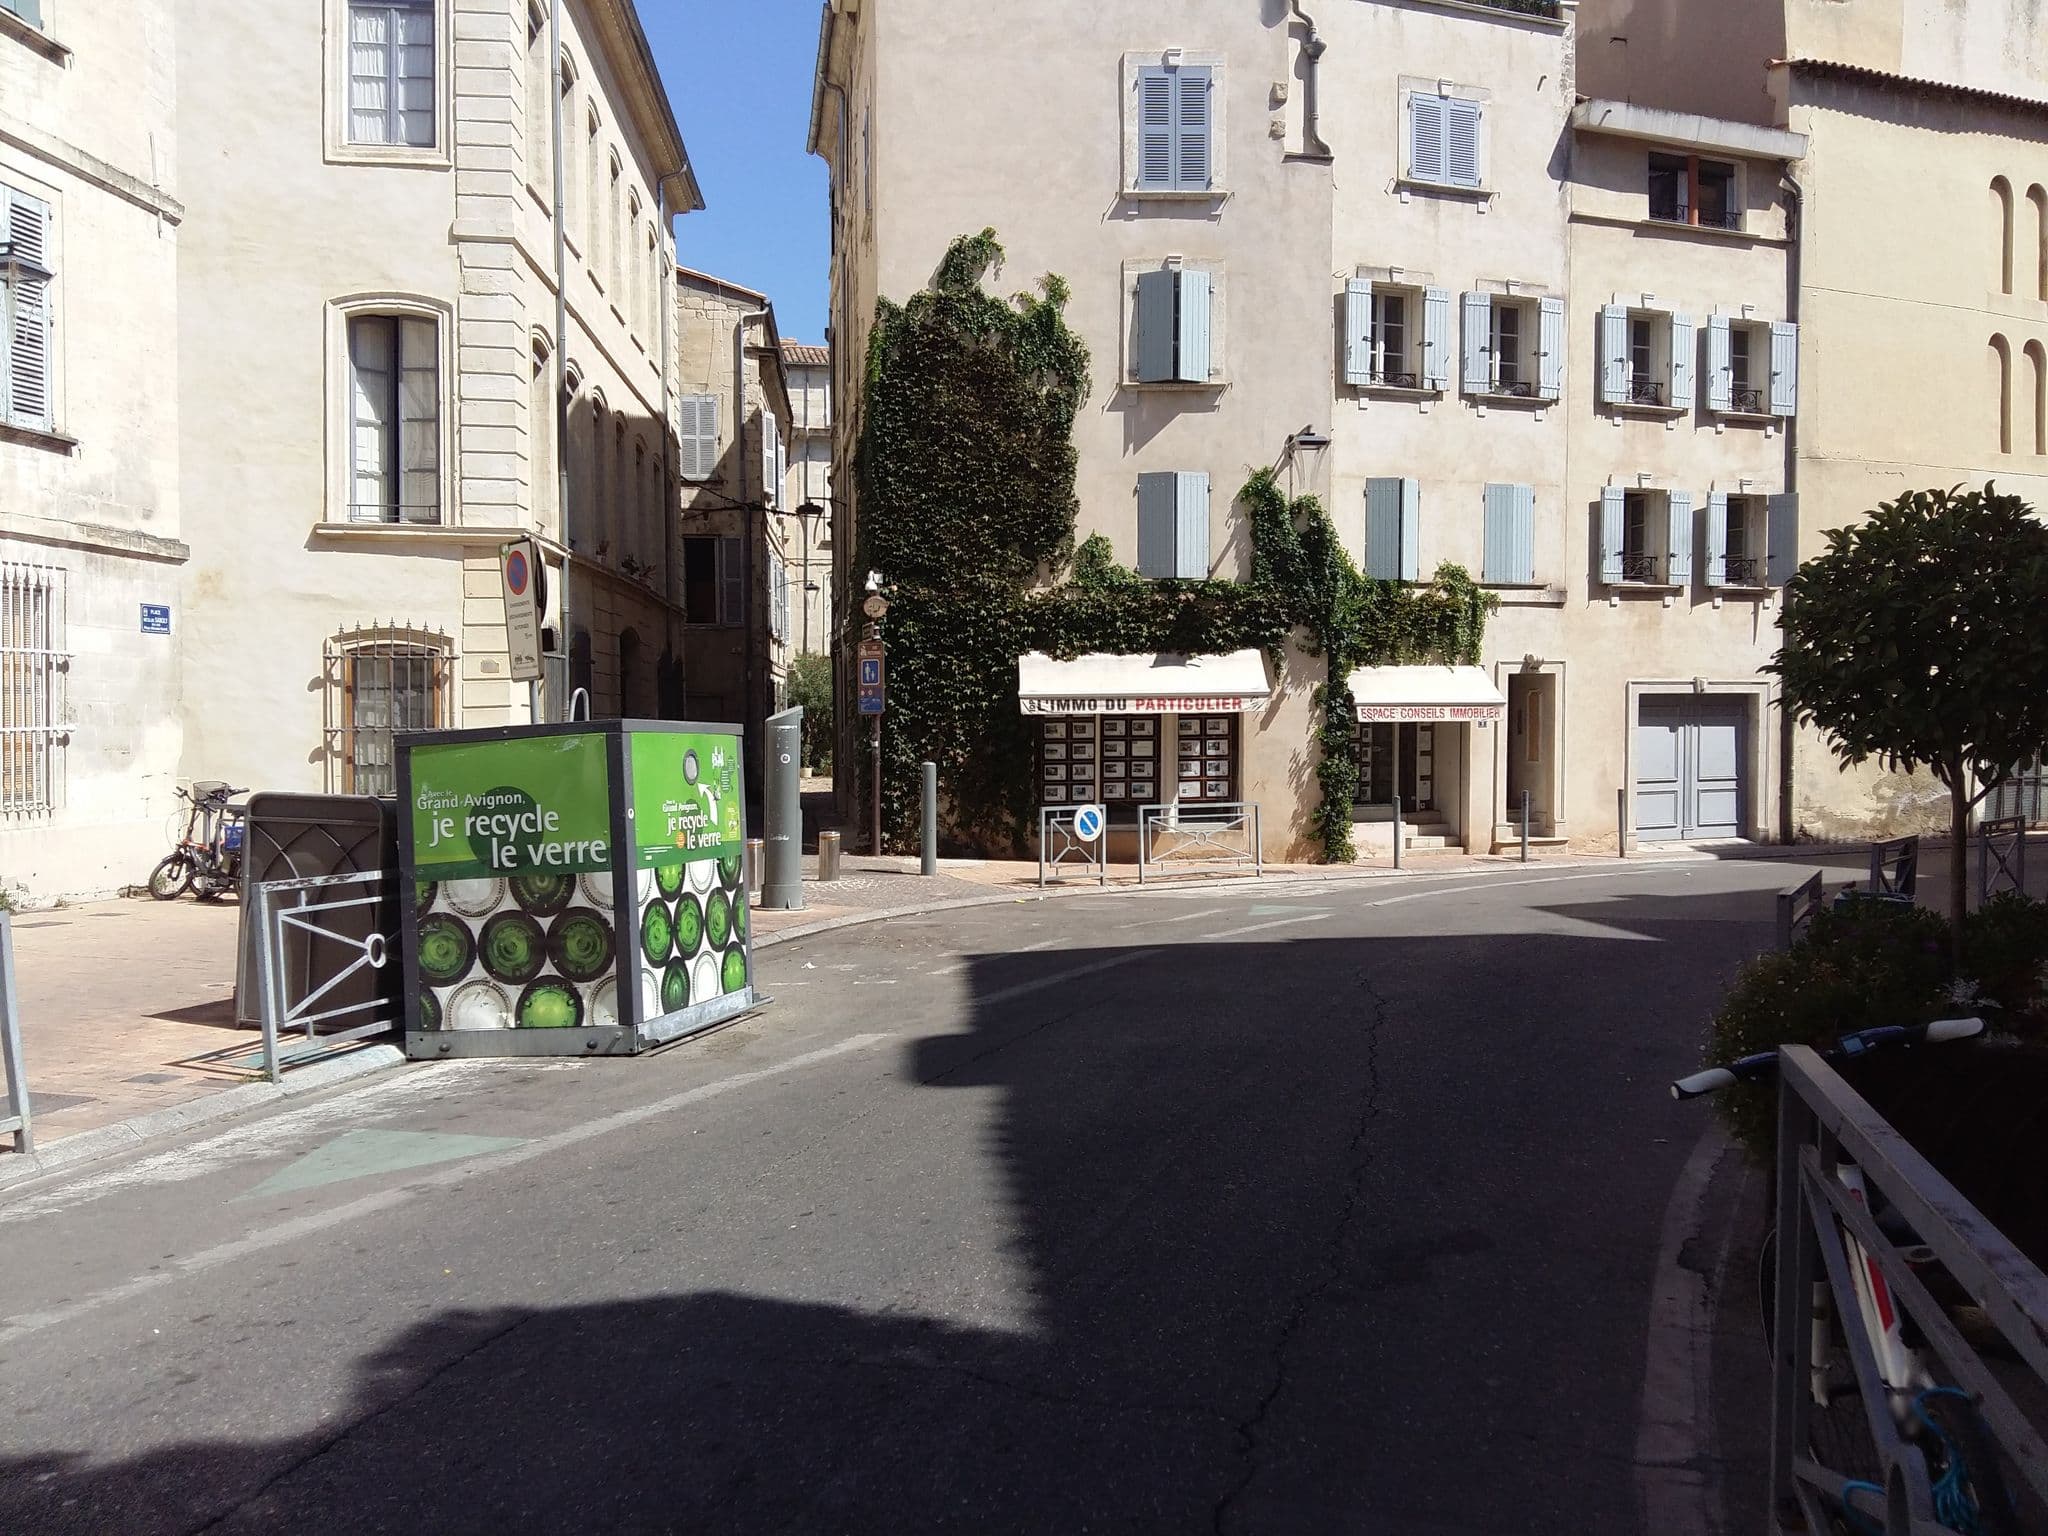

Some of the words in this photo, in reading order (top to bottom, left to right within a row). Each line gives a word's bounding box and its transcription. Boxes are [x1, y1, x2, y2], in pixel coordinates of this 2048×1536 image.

[1037, 698, 1098, 711] L'IMMO
[1105, 698, 1127, 711] DU
[1135, 697, 1242, 711] PARTICULIER
[1360, 707, 1396, 719] ESPACE
[1400, 707, 1445, 719] CONSEILS
[417, 794, 459, 810] Grand
[429, 811, 455, 848] je
[465, 804, 560, 842] recycle
[666, 812, 677, 837] je
[679, 810, 709, 834] recycle
[687, 830, 696, 850] le
[698, 831, 722, 848] verre
[492, 837, 518, 868] le
[527, 839, 608, 866] verre
